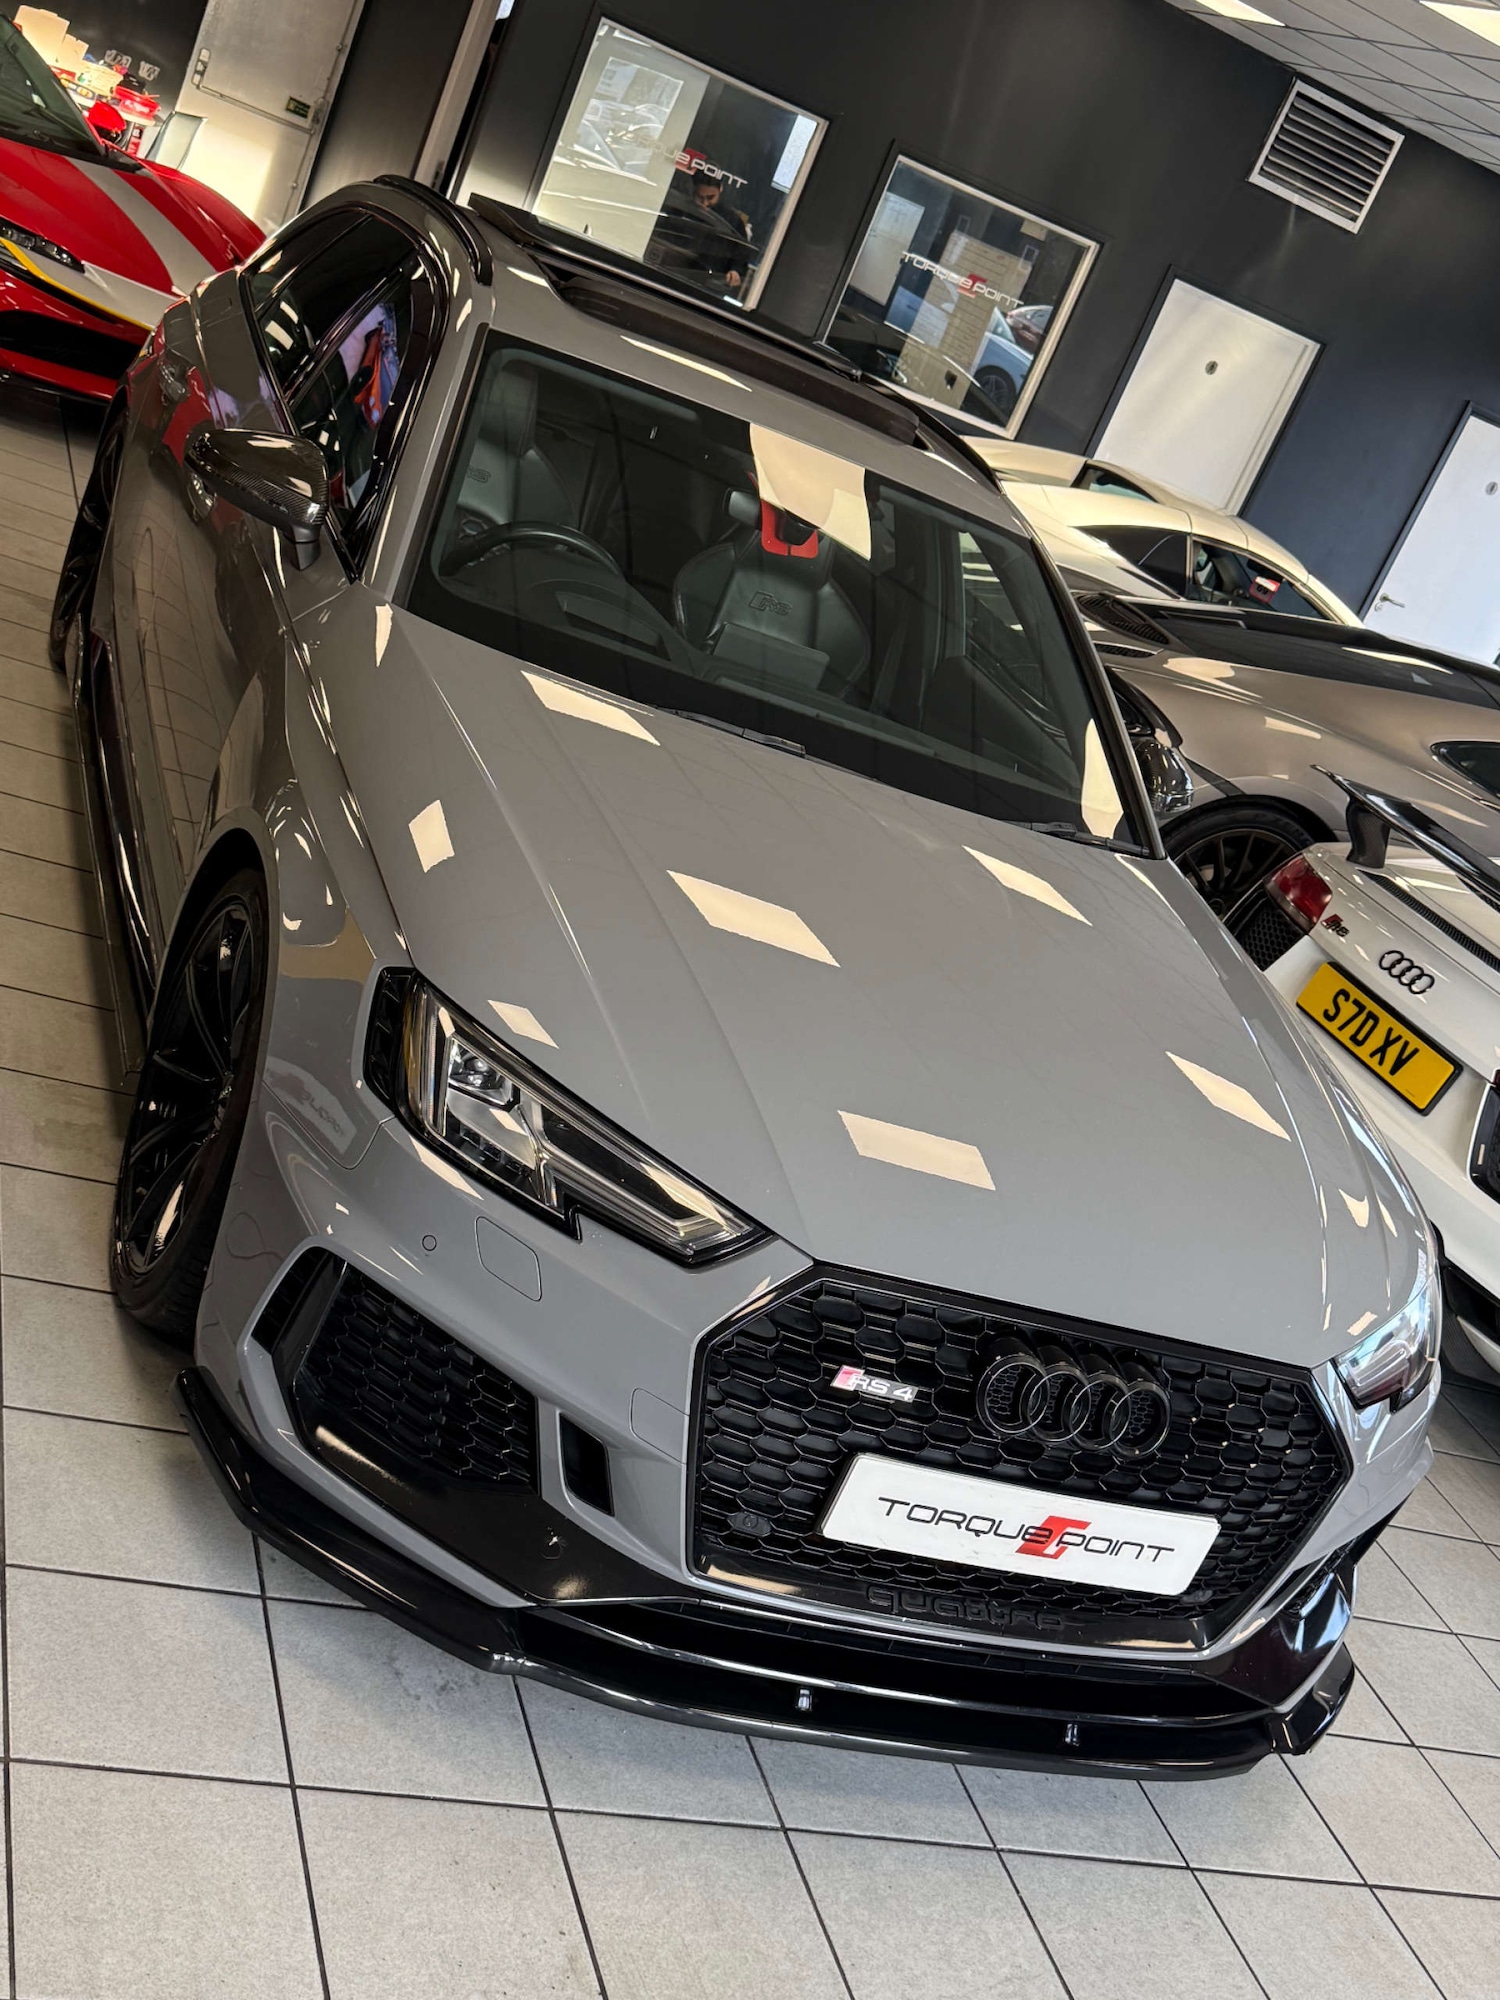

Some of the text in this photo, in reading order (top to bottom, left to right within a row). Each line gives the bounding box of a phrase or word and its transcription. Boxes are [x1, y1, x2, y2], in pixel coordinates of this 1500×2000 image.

[691, 158, 748, 188] POINT
[902, 251, 1024, 309] TORQUE POINT
[1323, 988, 1420, 1076] S7D XV
[878, 1496, 1175, 1563] TORQUE POINT
[866, 1586, 1067, 1630] quattro
